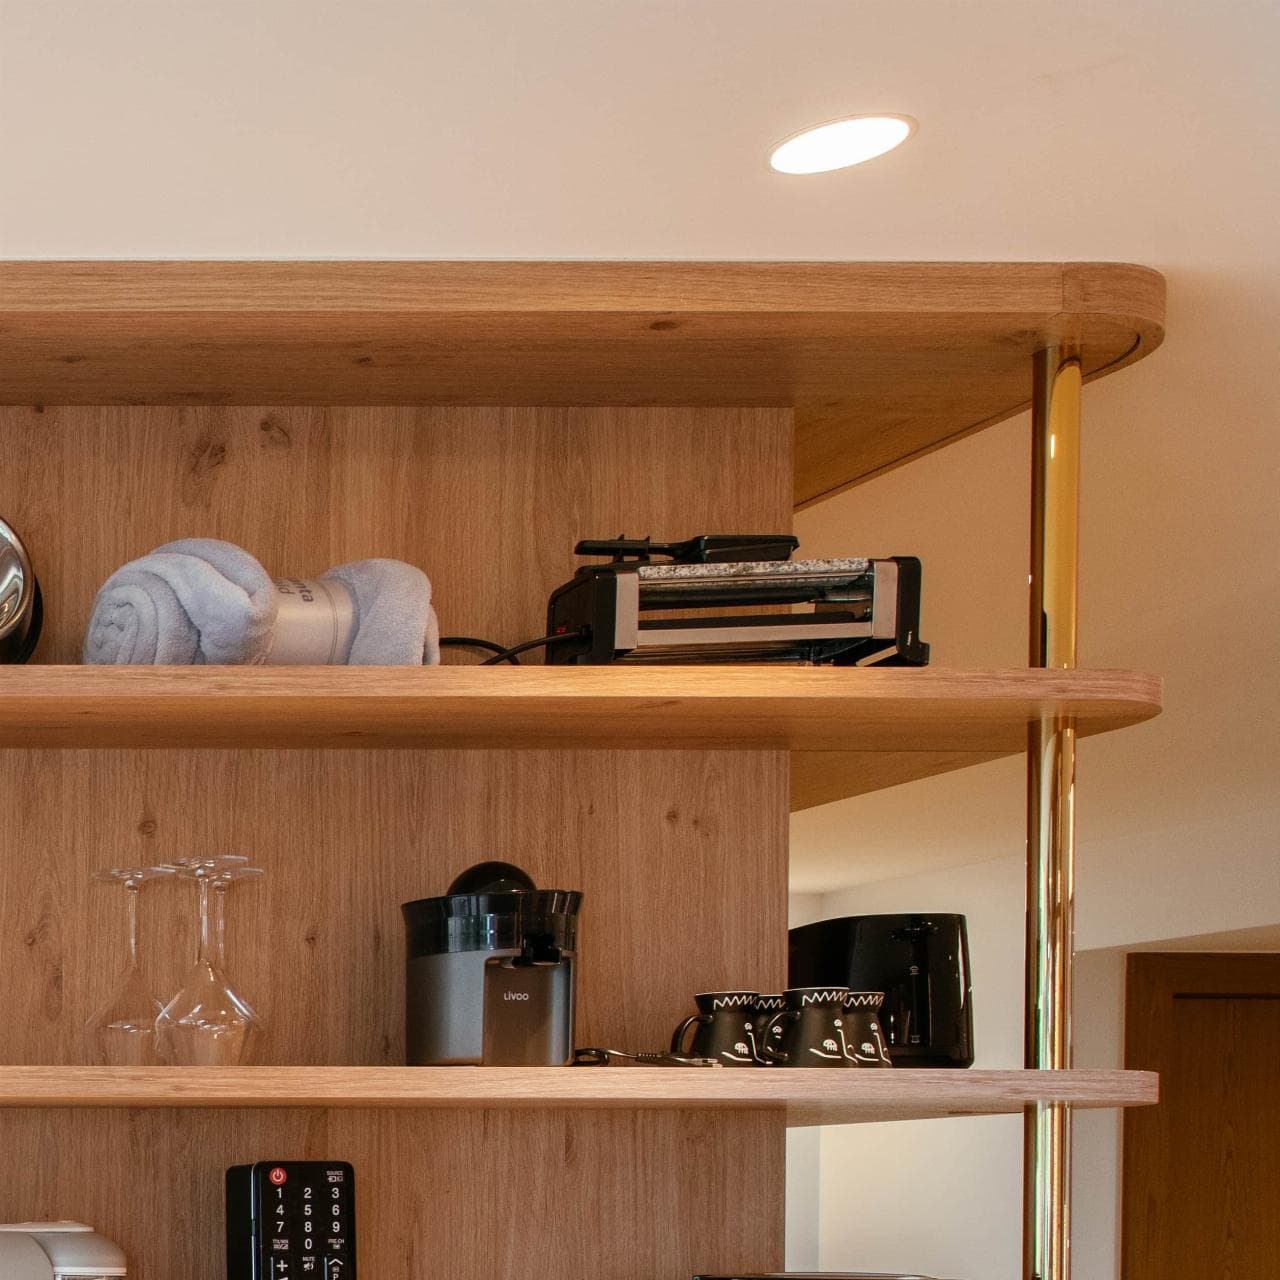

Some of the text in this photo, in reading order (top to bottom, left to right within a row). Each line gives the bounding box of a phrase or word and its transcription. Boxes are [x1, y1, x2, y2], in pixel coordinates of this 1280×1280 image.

[276, 1187, 339, 1198] 1 2 3
[276, 1204, 340, 1215] 4 5 6
[276, 1221, 340, 1232] 7 8 9
[304, 1238, 312, 1249] 0
